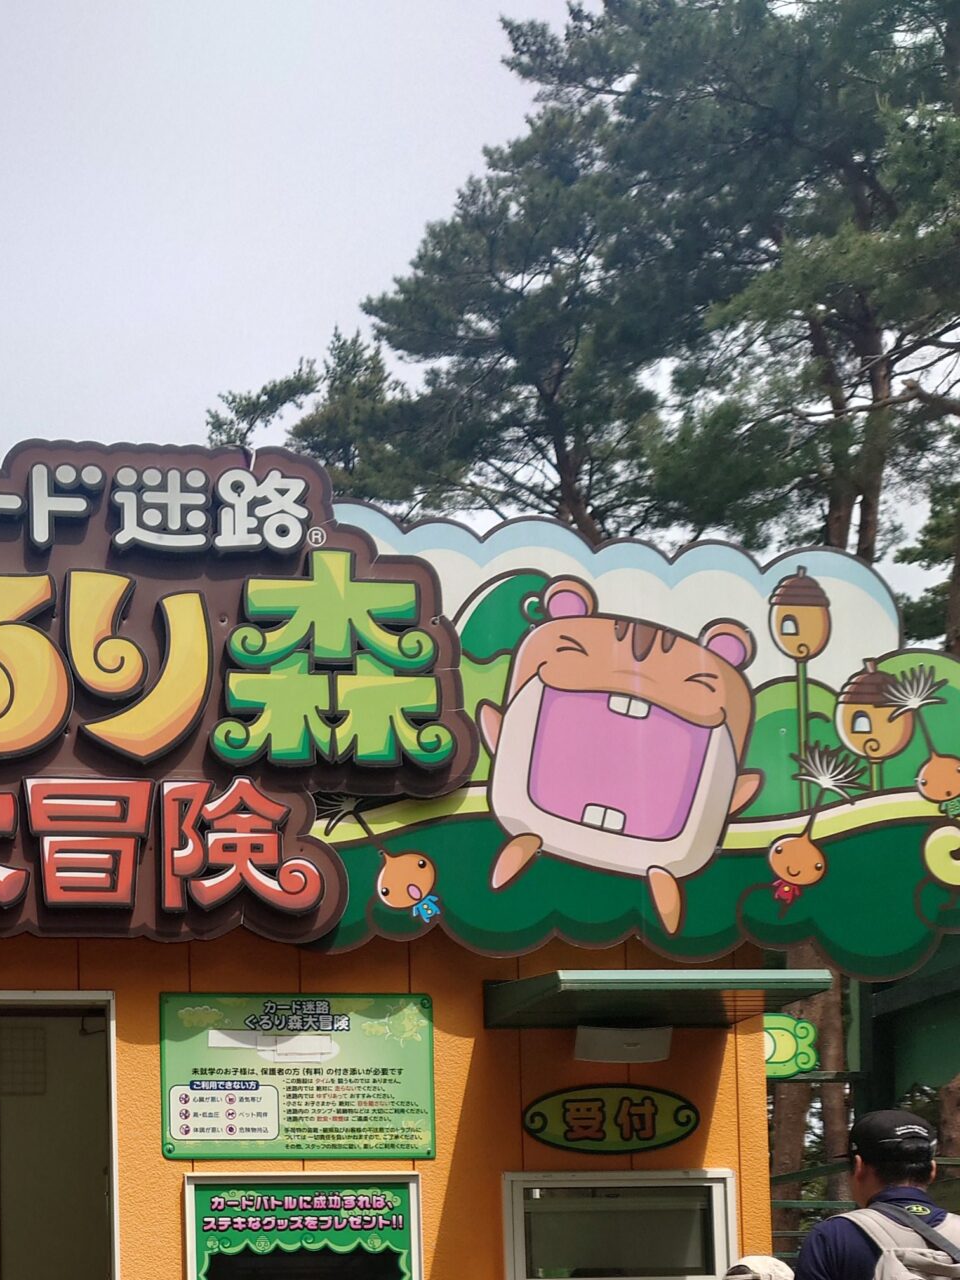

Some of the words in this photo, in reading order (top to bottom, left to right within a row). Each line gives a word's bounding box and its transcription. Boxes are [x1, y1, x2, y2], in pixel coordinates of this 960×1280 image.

[264, 1000, 330, 1015] カード迷路
[243, 1014, 351, 1032] ぐるり森大冒険
[193, 1081, 257, 1090] ご利用できない方
[562, 1097, 658, 1142] 受付
